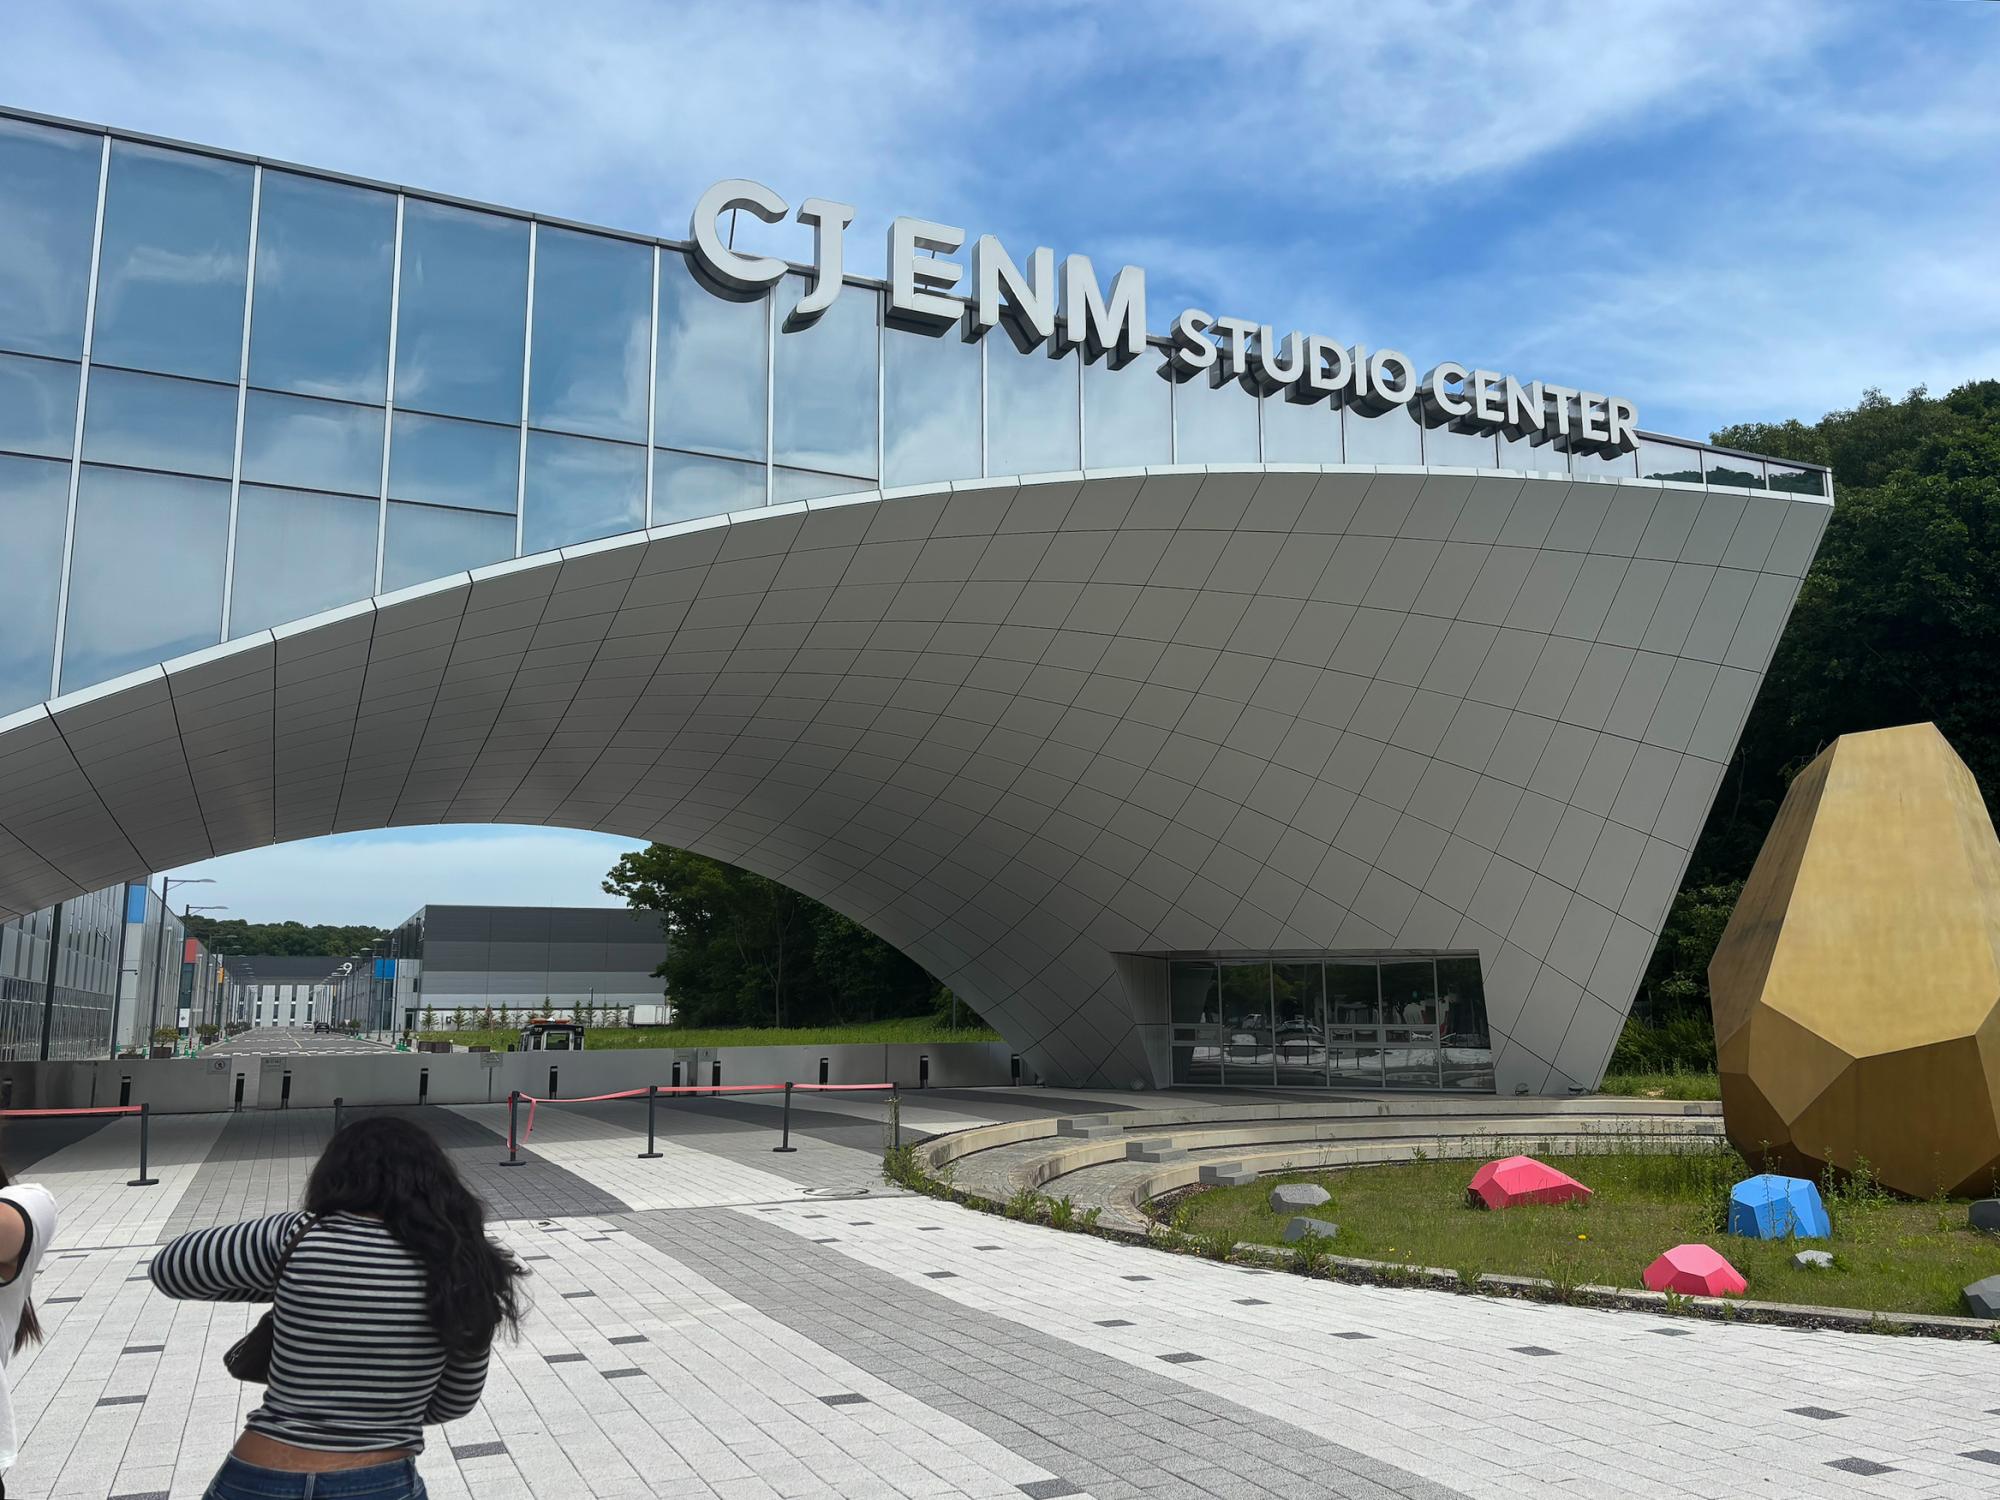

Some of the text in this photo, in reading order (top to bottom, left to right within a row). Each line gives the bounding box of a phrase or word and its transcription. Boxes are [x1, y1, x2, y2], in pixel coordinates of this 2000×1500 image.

[691, 178, 1640, 450] CJ ENM STUDIO CENTER
